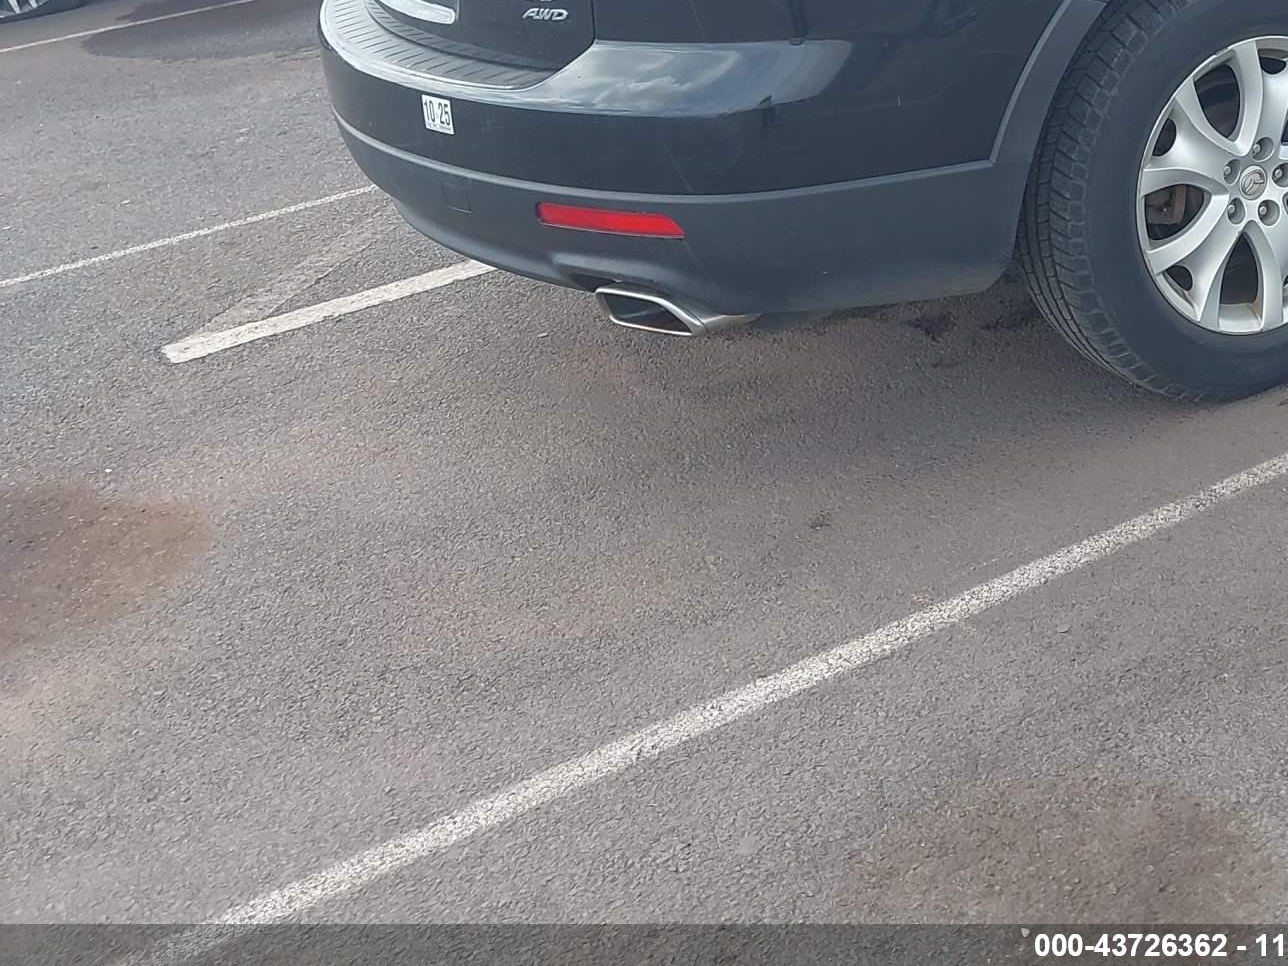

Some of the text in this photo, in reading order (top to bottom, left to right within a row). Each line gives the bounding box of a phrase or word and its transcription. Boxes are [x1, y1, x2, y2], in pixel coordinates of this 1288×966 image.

[522, 7, 568, 21] AWD
[424, 99, 451, 126] 10 25
